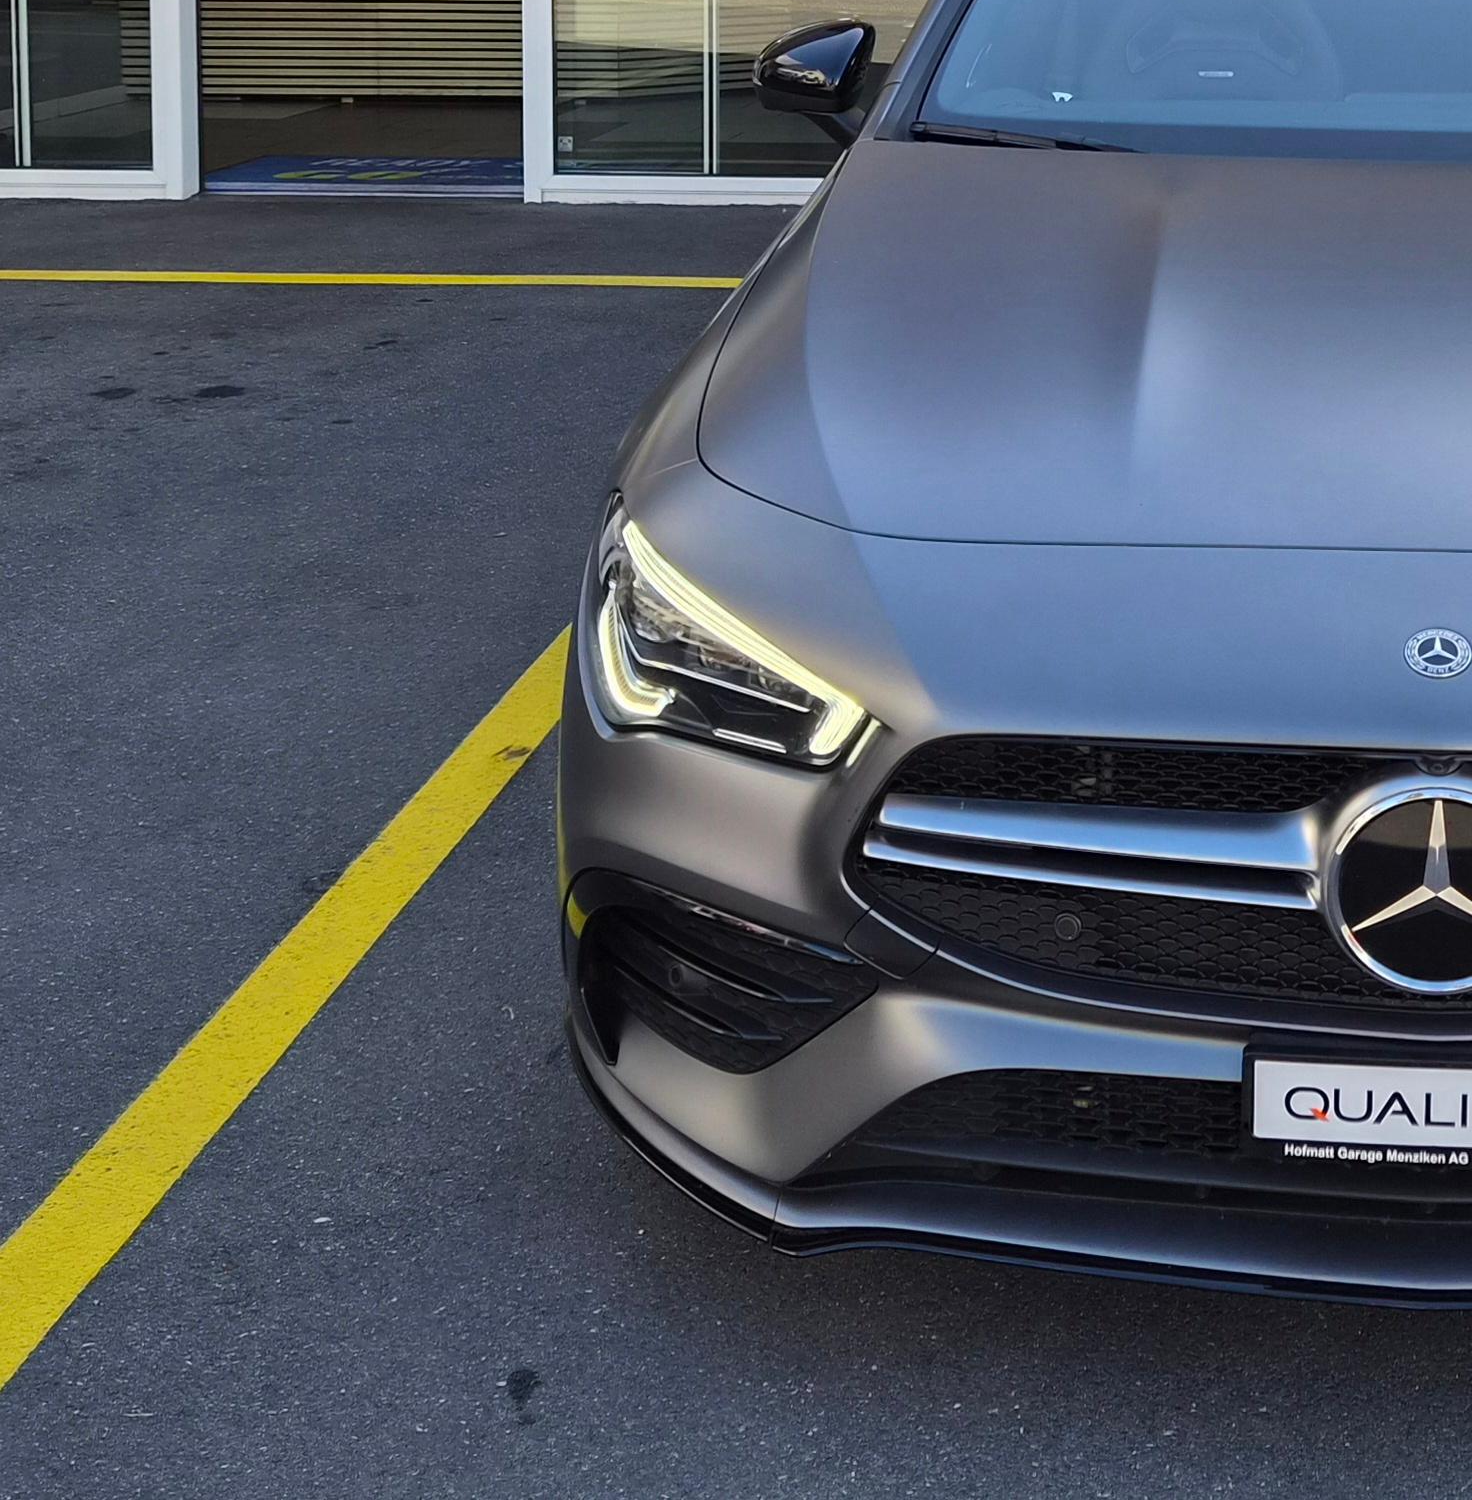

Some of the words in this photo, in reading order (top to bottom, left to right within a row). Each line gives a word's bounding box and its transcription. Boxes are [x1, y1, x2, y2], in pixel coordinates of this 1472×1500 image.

[1284, 1142, 1335, 1159] Hofmatt
[1337, 1146, 1383, 1164] Garage
[1386, 1148, 1446, 1165] Menziken
[1448, 1151, 1469, 1165] AG
